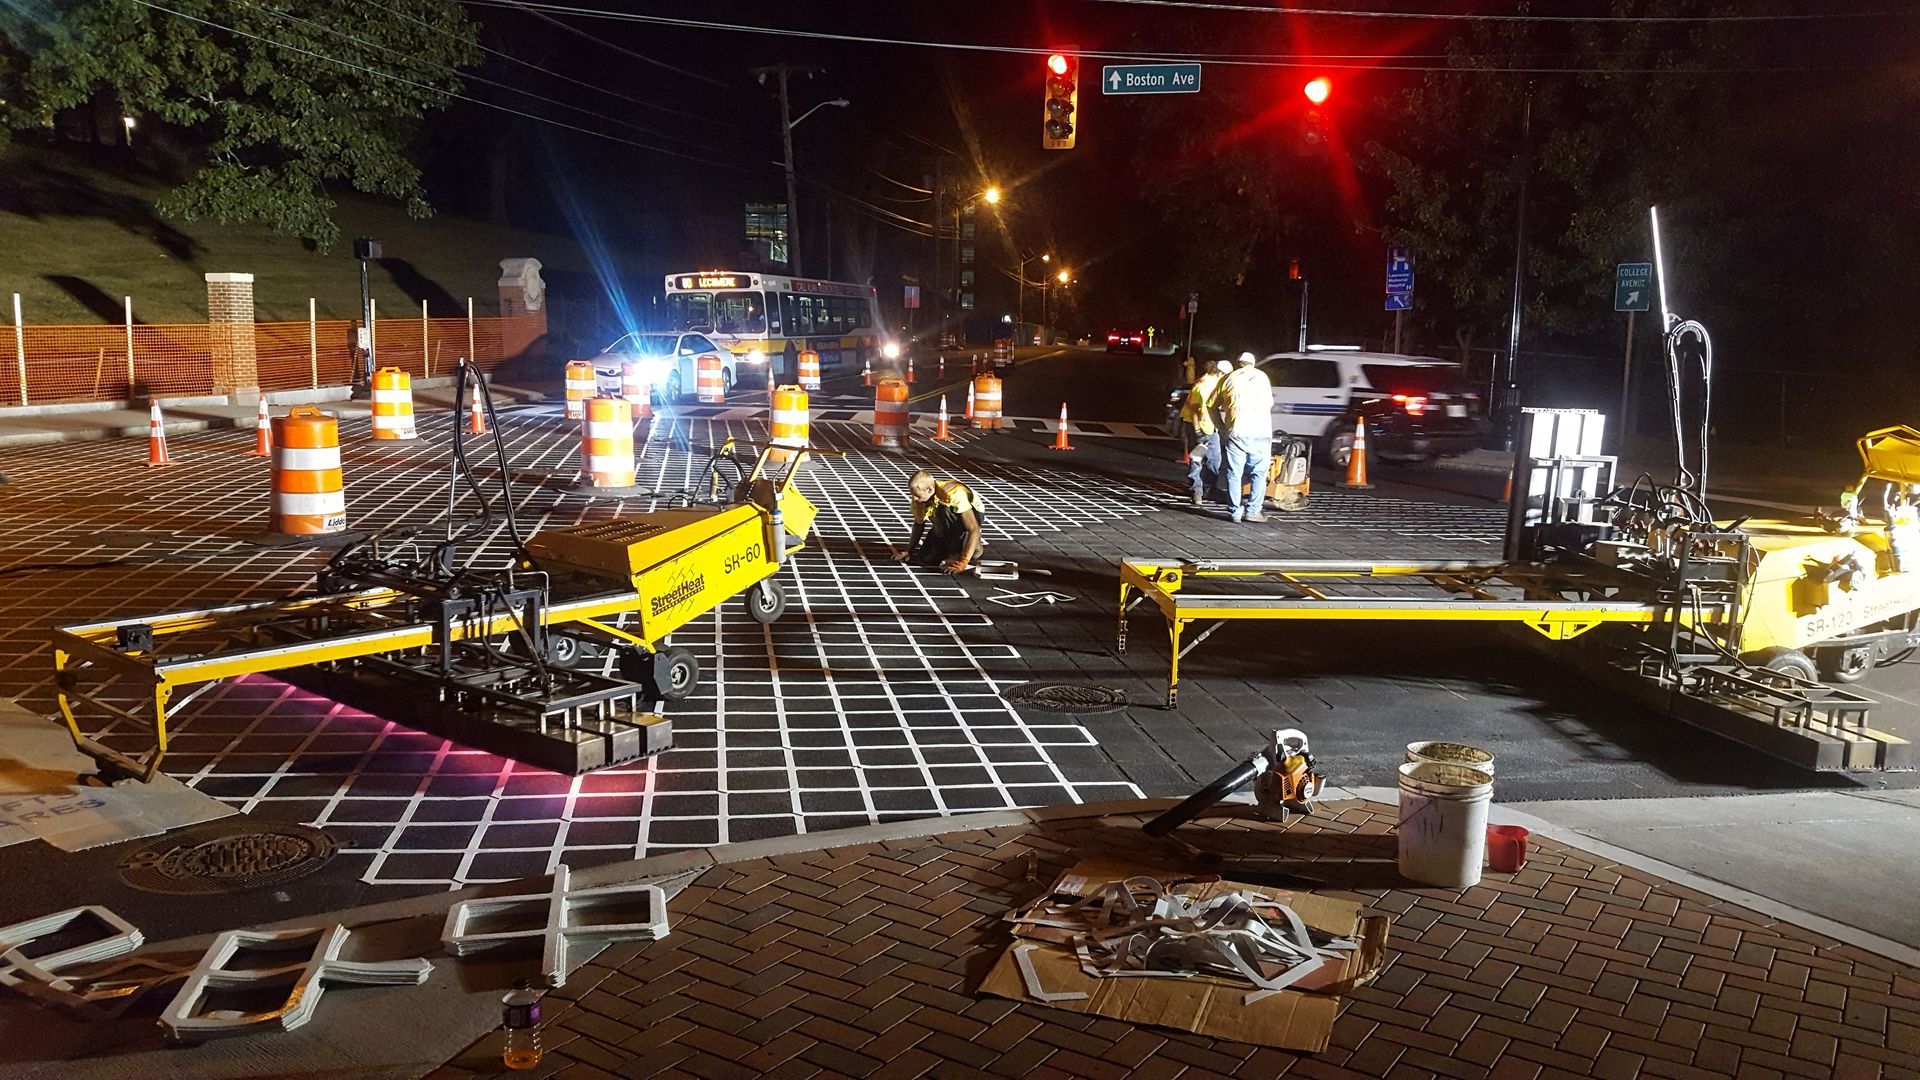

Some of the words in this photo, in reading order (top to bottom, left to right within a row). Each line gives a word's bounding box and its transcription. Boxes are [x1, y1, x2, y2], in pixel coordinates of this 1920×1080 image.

[1126, 73, 1165, 86] Boston
[1172, 72, 1195, 85] Ave
[1620, 268, 1649, 277] COLLEGE
[1621, 280, 1645, 288] AVENUE
[651, 573, 705, 613] StreetHeat
[724, 543, 761, 575] SR-60
[1807, 611, 1853, 637] SR-120
